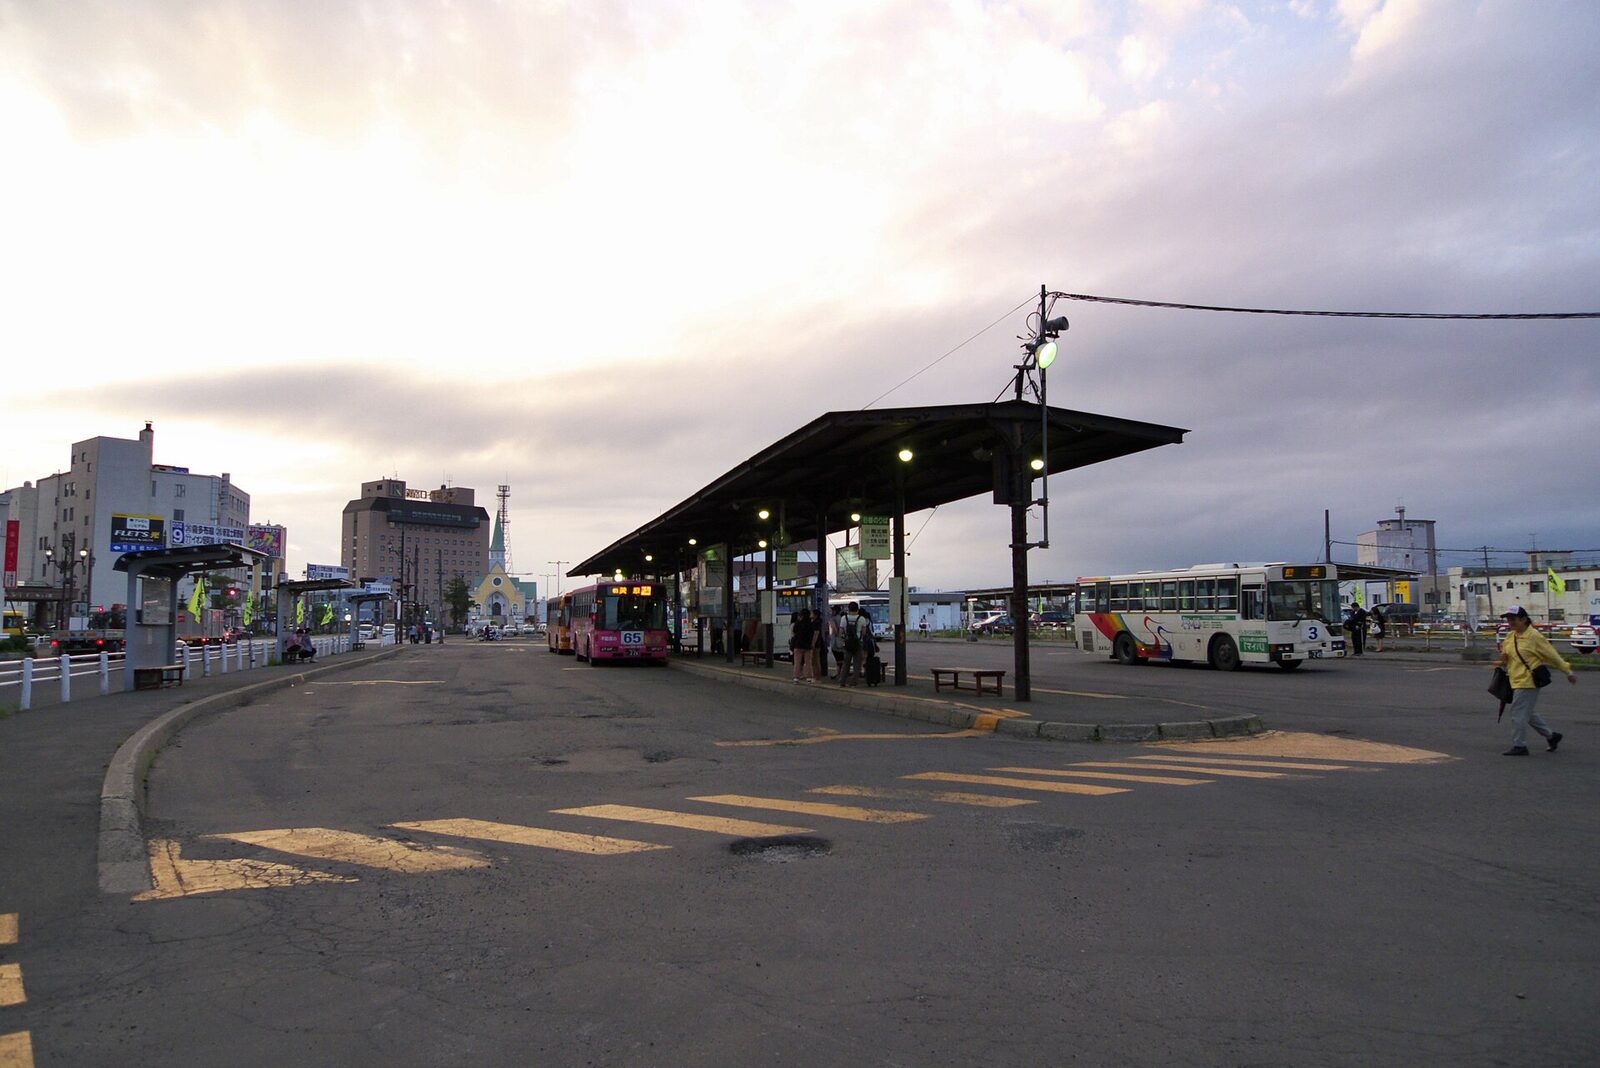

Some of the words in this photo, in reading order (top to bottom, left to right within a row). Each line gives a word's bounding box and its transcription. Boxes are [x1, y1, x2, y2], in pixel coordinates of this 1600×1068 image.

[173, 529, 183, 543] 9
[623, 632, 641, 644] 65
[1308, 626, 1318, 640] 3
